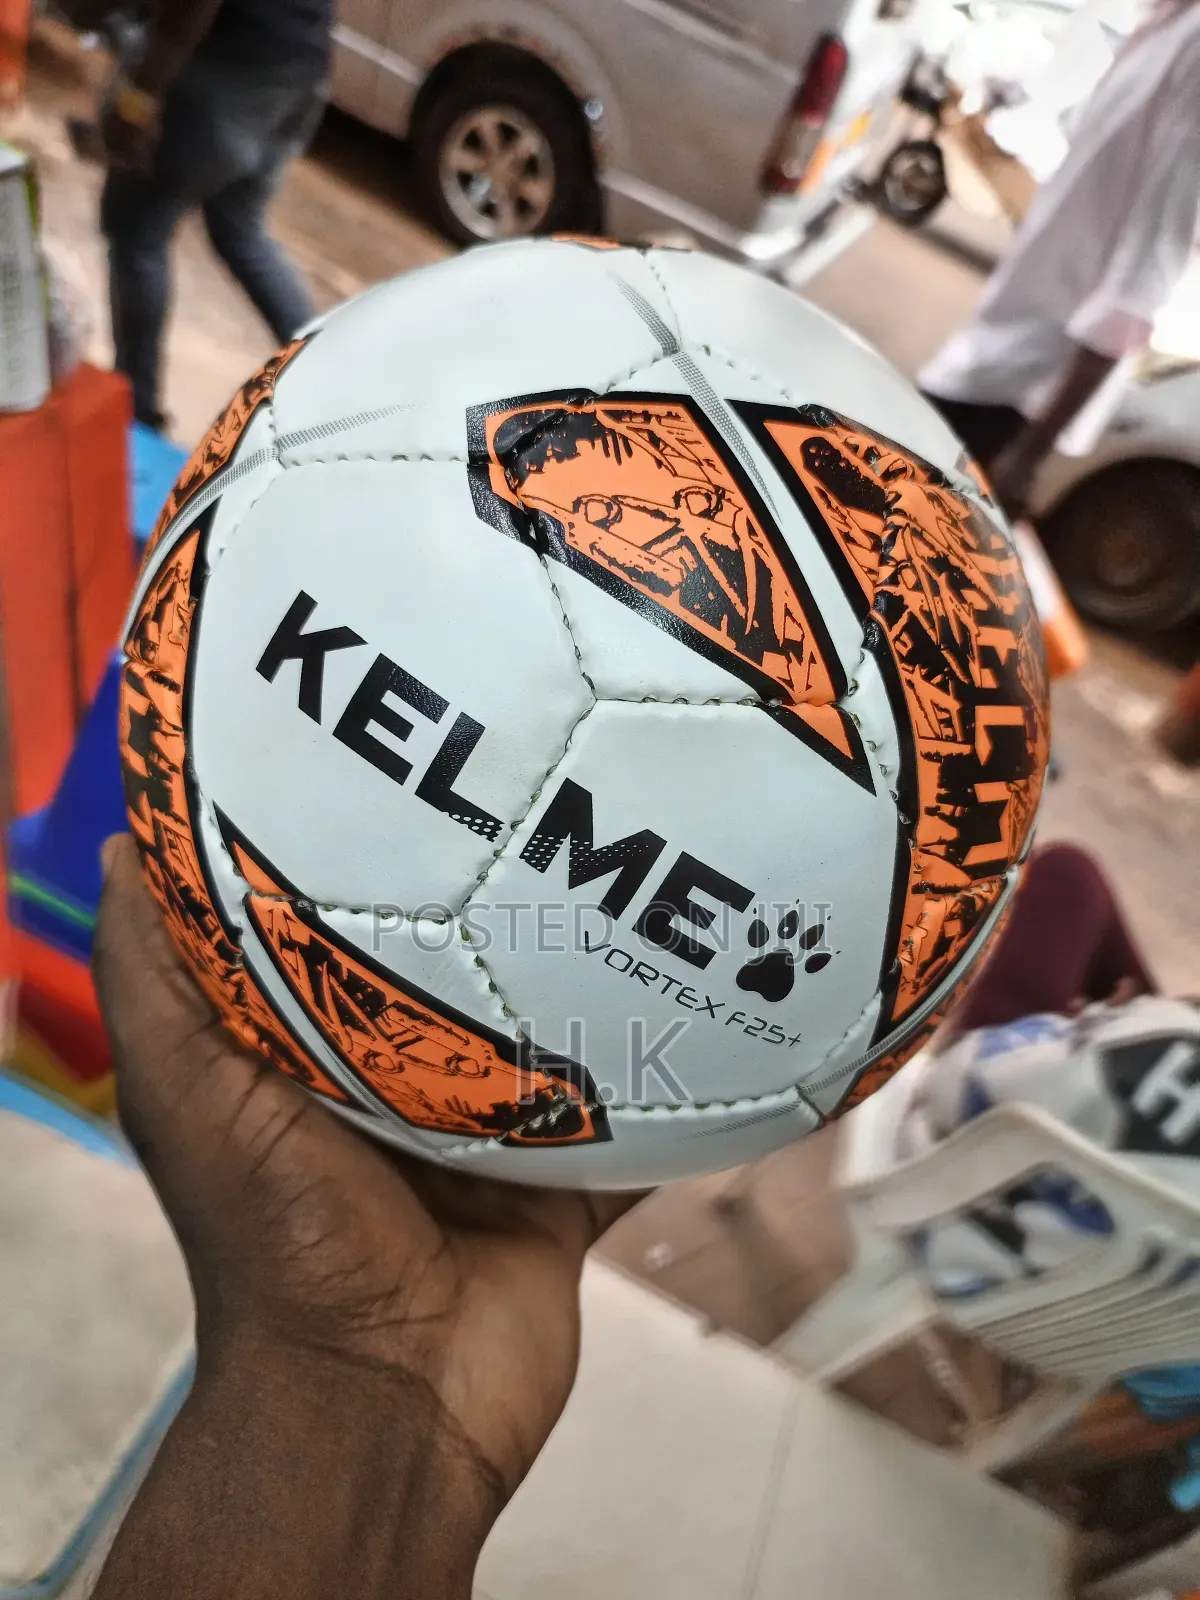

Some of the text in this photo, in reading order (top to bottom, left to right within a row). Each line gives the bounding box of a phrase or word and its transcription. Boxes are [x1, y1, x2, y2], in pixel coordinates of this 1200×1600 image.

[255, 589, 757, 971] KELME
[584, 930, 802, 1048] VORTEX F25+
